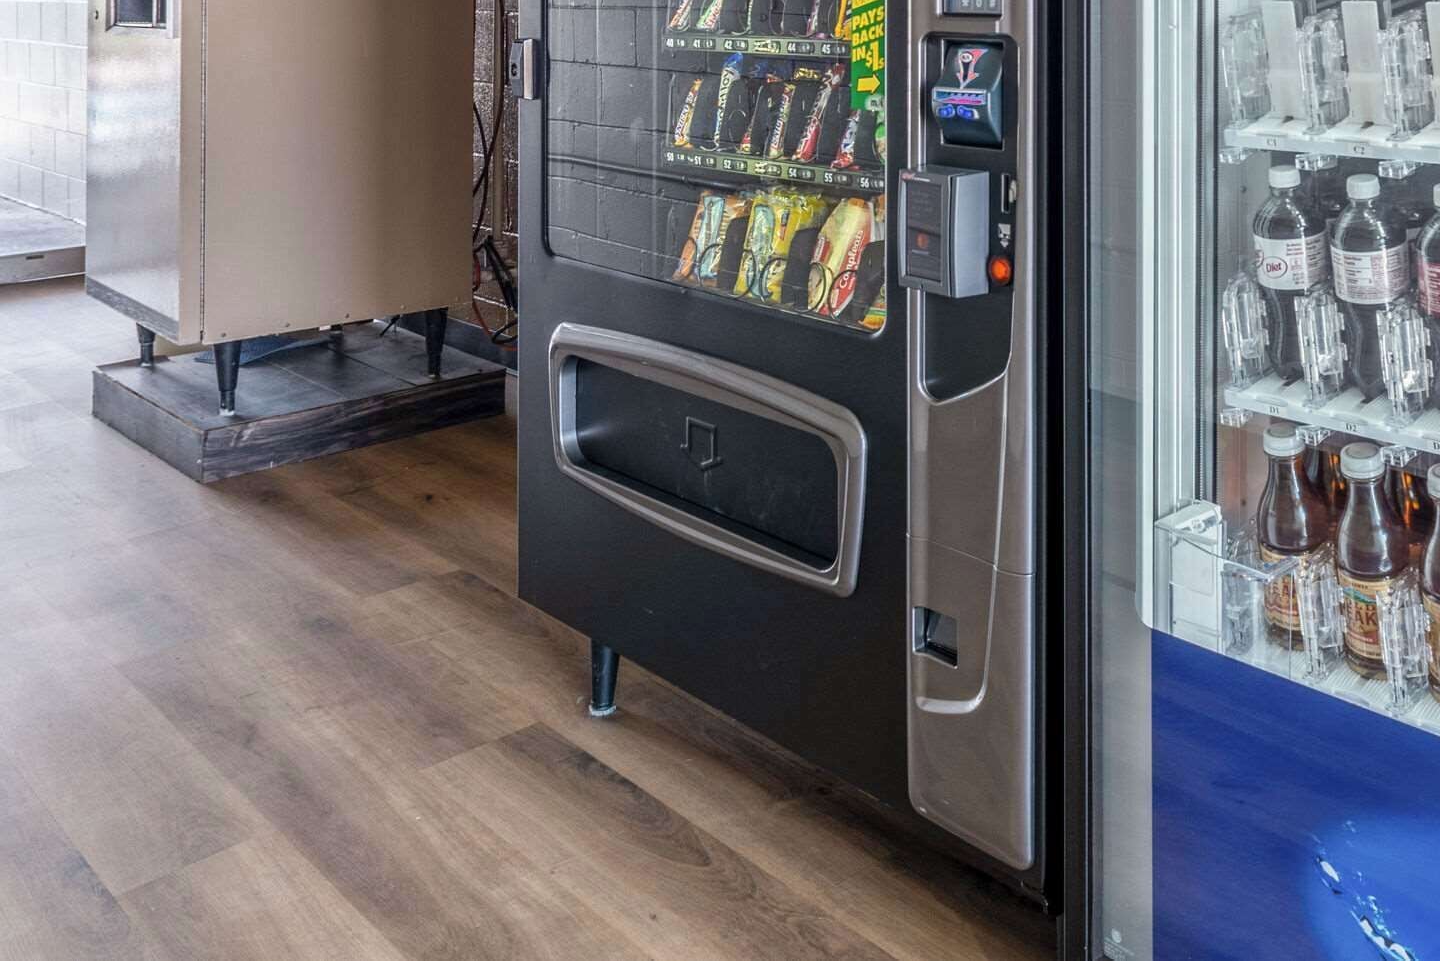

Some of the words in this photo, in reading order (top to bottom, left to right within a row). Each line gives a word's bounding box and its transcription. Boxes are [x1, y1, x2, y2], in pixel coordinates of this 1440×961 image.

[852, 6, 885, 31] PAYS
[852, 24, 884, 47] BACK
[724, 40, 733, 50] 42
[787, 42, 797, 52] 44
[821, 44, 831, 54] 45
[852, 44, 866, 62] IN
[1353, 145, 1366, 154] C2
[723, 159, 732, 169] 52
[788, 168, 797, 178] 54
[824, 173, 833, 183] 55
[860, 177, 870, 187] 56
[1266, 262, 1282, 272] Diet
[1269, 406, 1280, 415] D1
[1345, 423, 1357, 432] D2
